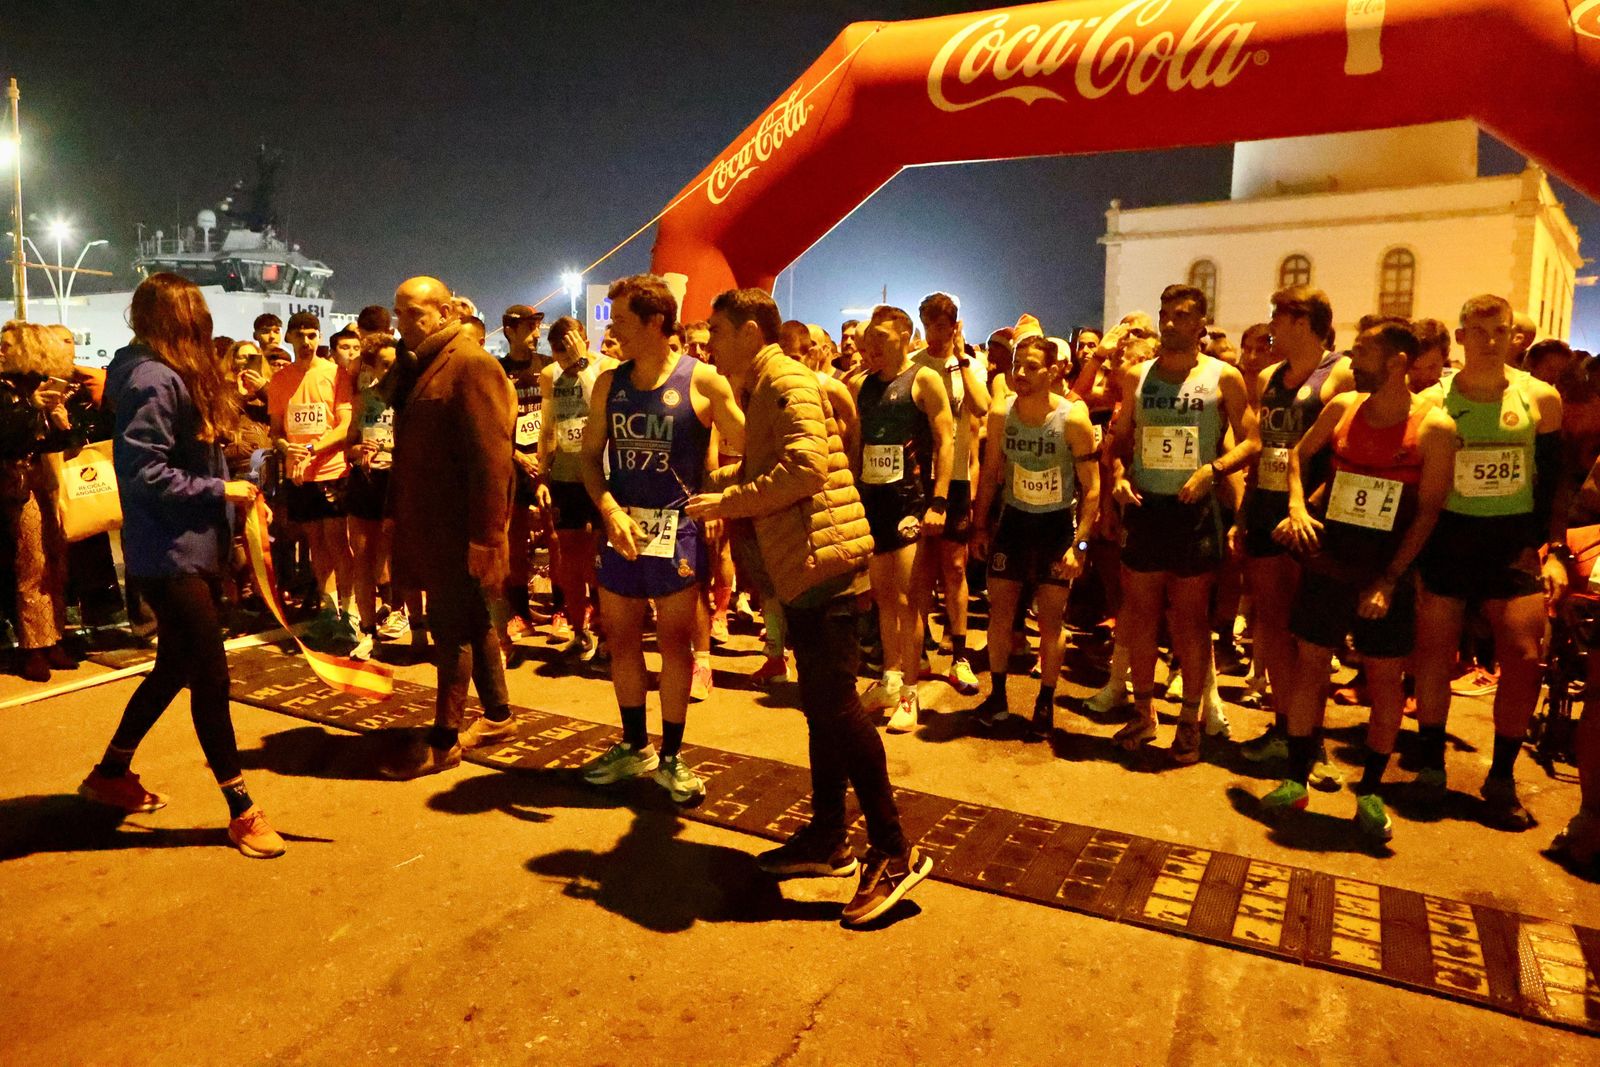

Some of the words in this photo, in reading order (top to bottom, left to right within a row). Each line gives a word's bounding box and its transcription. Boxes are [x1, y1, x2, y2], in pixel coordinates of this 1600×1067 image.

[927, 0, 1253, 112] Coca-Cola
[1143, 393, 1204, 414] nerja
[294, 411, 315, 422] 870
[520, 419, 540, 434] 490
[567, 427, 584, 441] 53
[612, 412, 674, 440] RCM
[1006, 436, 1056, 458] nerja
[1162, 439, 1172, 453] 5
[617, 449, 670, 472] 1873
[869, 457, 891, 468] 1160
[1473, 463, 1510, 480] 528
[1022, 480, 1049, 491] 1091
[1355, 489, 1368, 506] 8
[640, 520, 660, 537] 34
